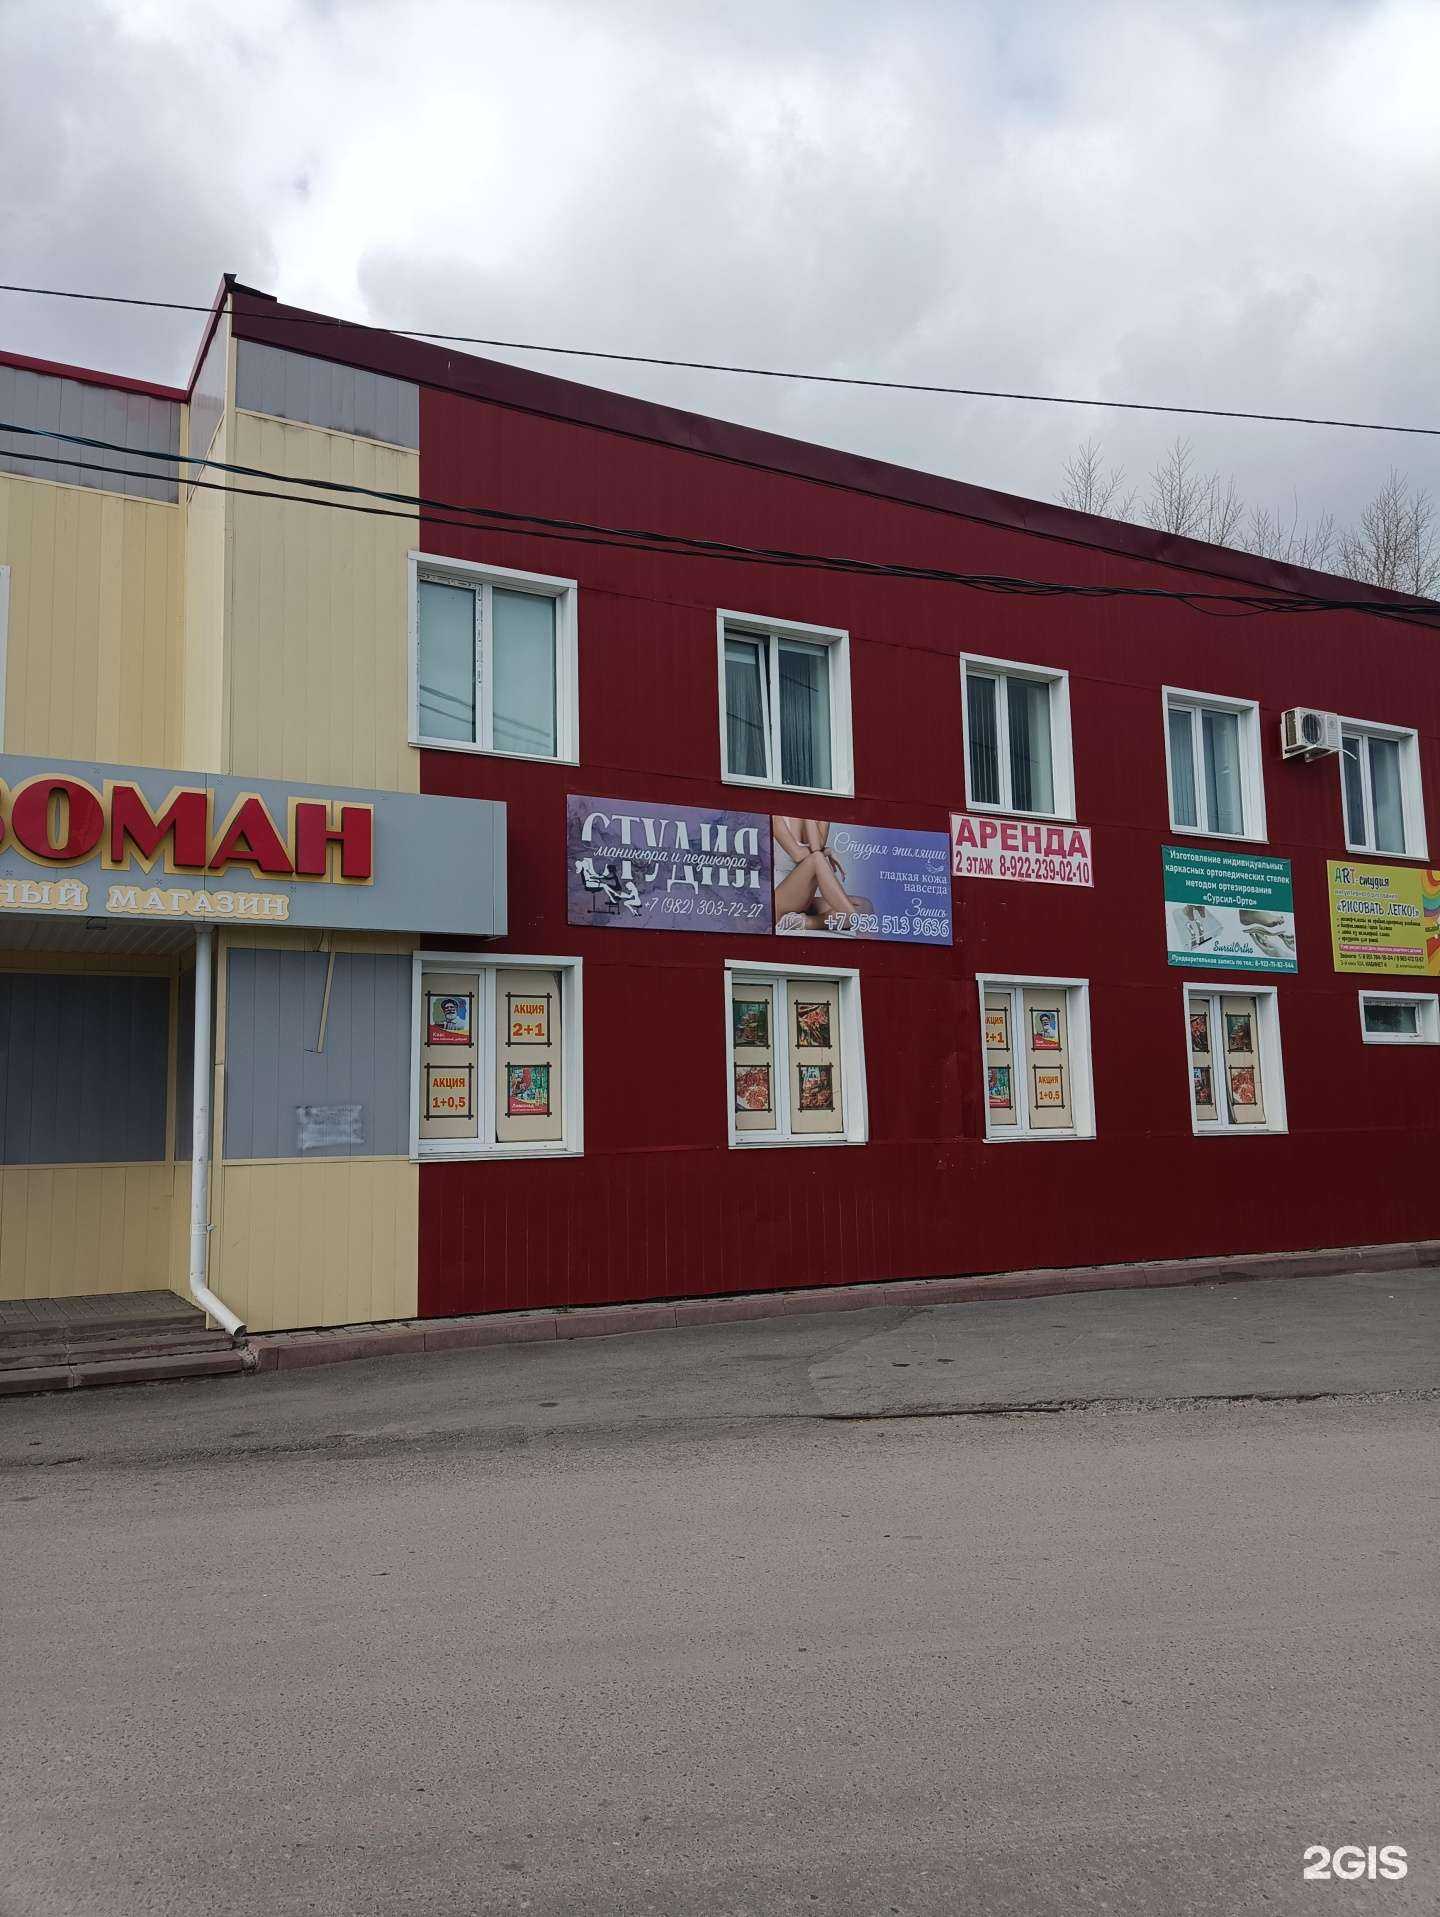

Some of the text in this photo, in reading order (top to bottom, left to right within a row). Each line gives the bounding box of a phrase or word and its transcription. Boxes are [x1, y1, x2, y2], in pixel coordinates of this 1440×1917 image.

[0, 778, 373, 879] ОМАН
[955, 818, 1088, 859] АРЕНДА
[581, 812, 760, 894] СТУДИЯ
[833, 832, 947, 863] Студия эпиляции
[593, 845, 747, 871] маникюра и педикюра
[955, 851, 1089, 883] 2 ЭТАЖ 8-922-239-02-10
[1169, 850, 1284, 871] Изготовление индивидуальных
[880, 870, 948, 885] гладкая кожа
[1165, 864, 1205, 875] каркасных
[1206, 870, 1265, 882] ортопедических
[904, 884, 948, 896] навсегда
[1185, 880, 1272, 895] методом ортезирования
[109, 885, 288, 917] МАГАЗИН
[644, 897, 764, 918] +7 (982) 303-72-27
[904, 898, 947, 918] Запись
[824, 912, 950, 937] +7 952 513 9636
[513, 1004, 545, 1018] АКЦИЯ
[512, 1022, 545, 1037] 2+1
[432, 1077, 465, 1091] АКЦИЯ
[1038, 1075, 1059, 1085] АКЦИЯ
[432, 1096, 466, 1110] 1+0,5
